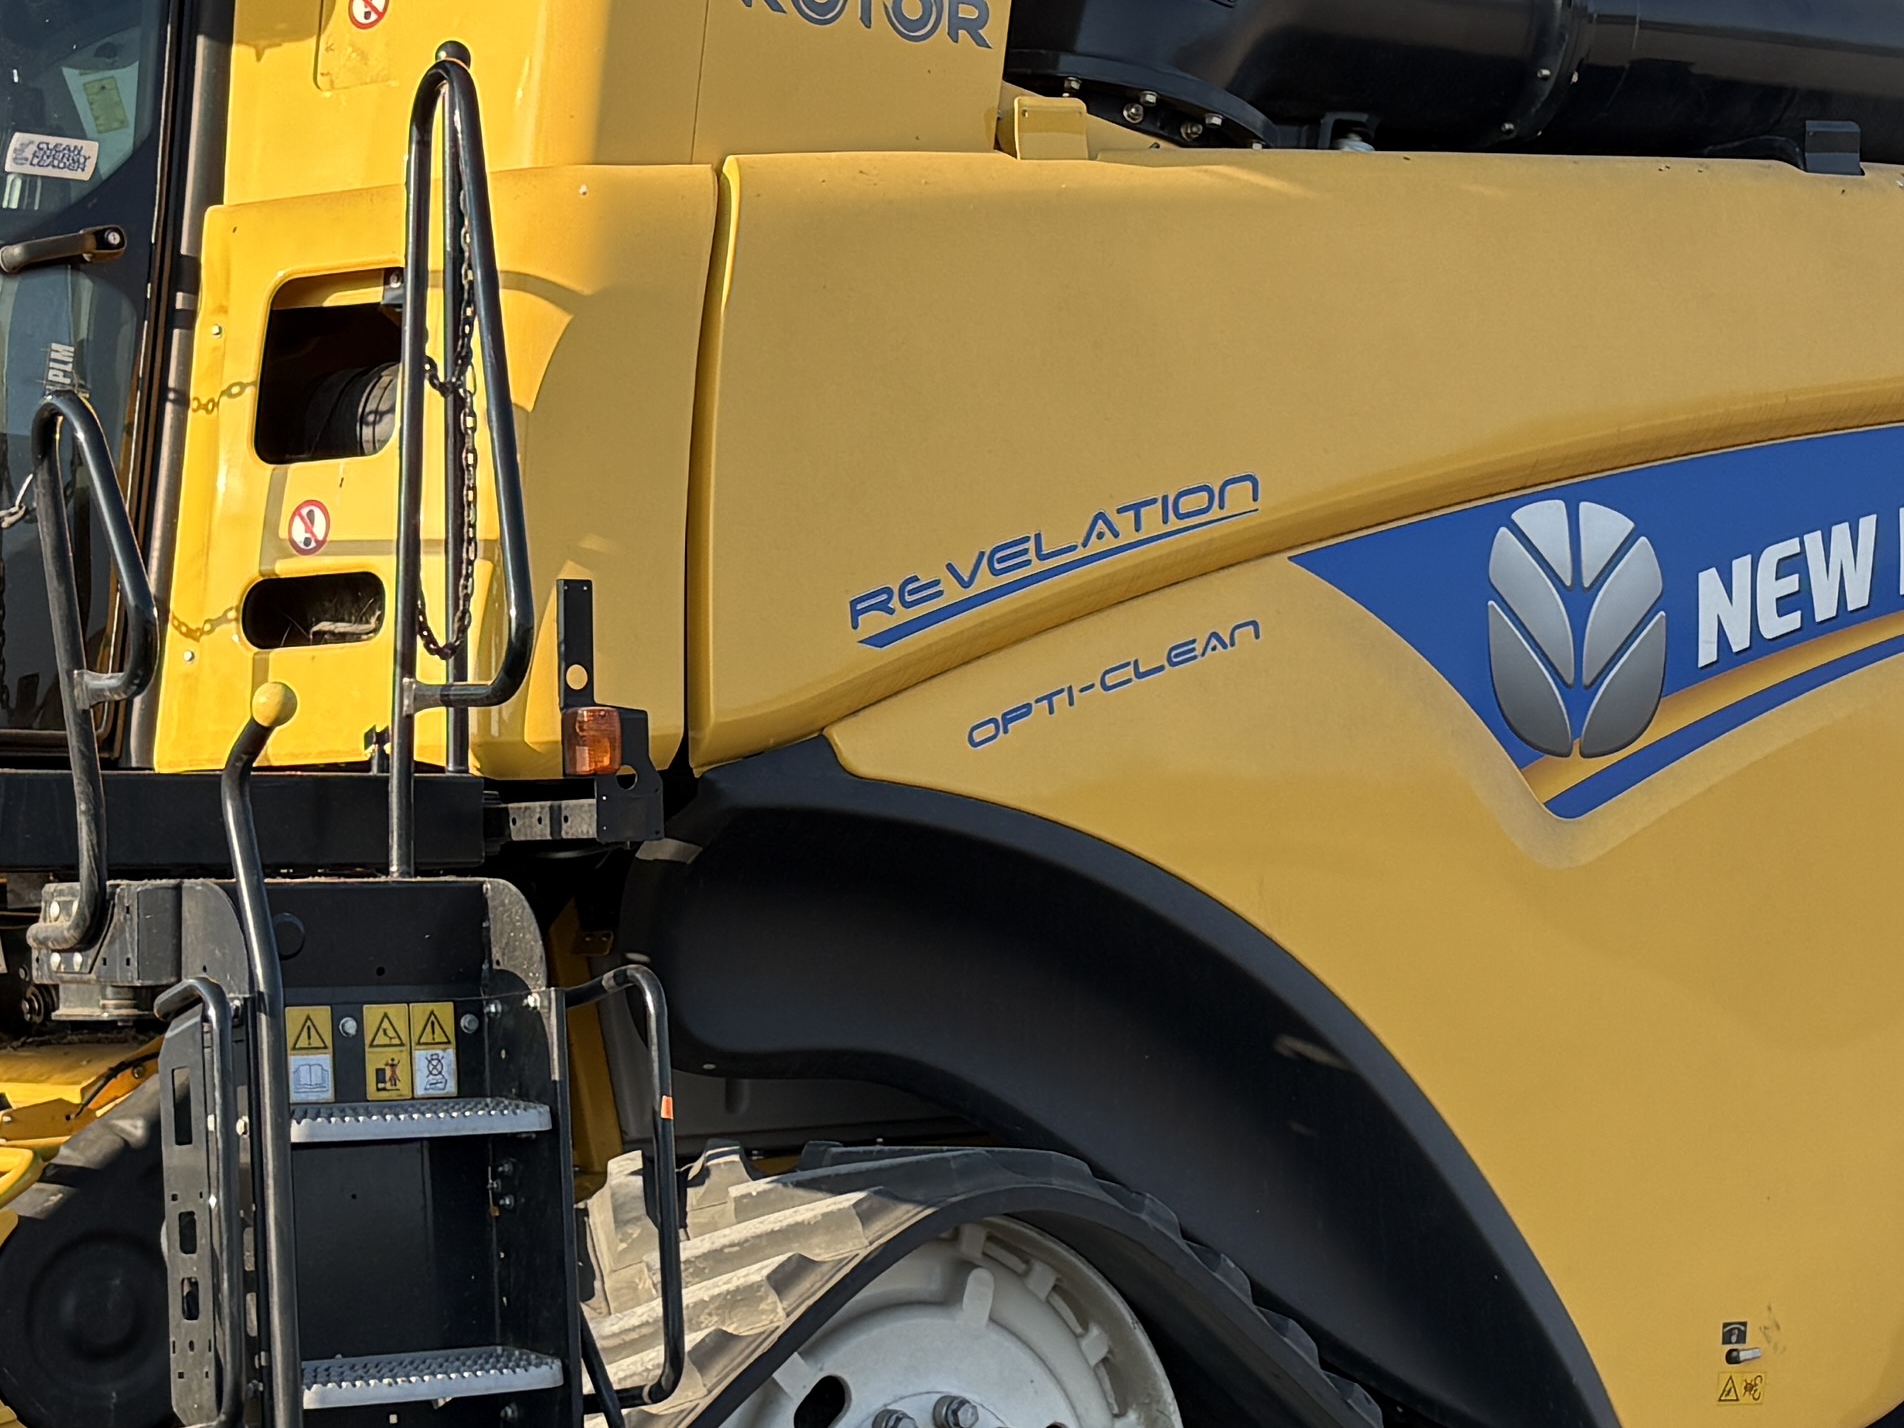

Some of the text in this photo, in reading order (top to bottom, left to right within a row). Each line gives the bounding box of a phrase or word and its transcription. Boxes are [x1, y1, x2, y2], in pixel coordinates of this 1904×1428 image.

[37, 141, 83, 155] CLEAN
[47, 342, 75, 385] PLM
[848, 471, 1260, 630] REVELATION
[1697, 513, 1878, 669] NEW
[966, 619, 1261, 749] OPTI-CLEAN
